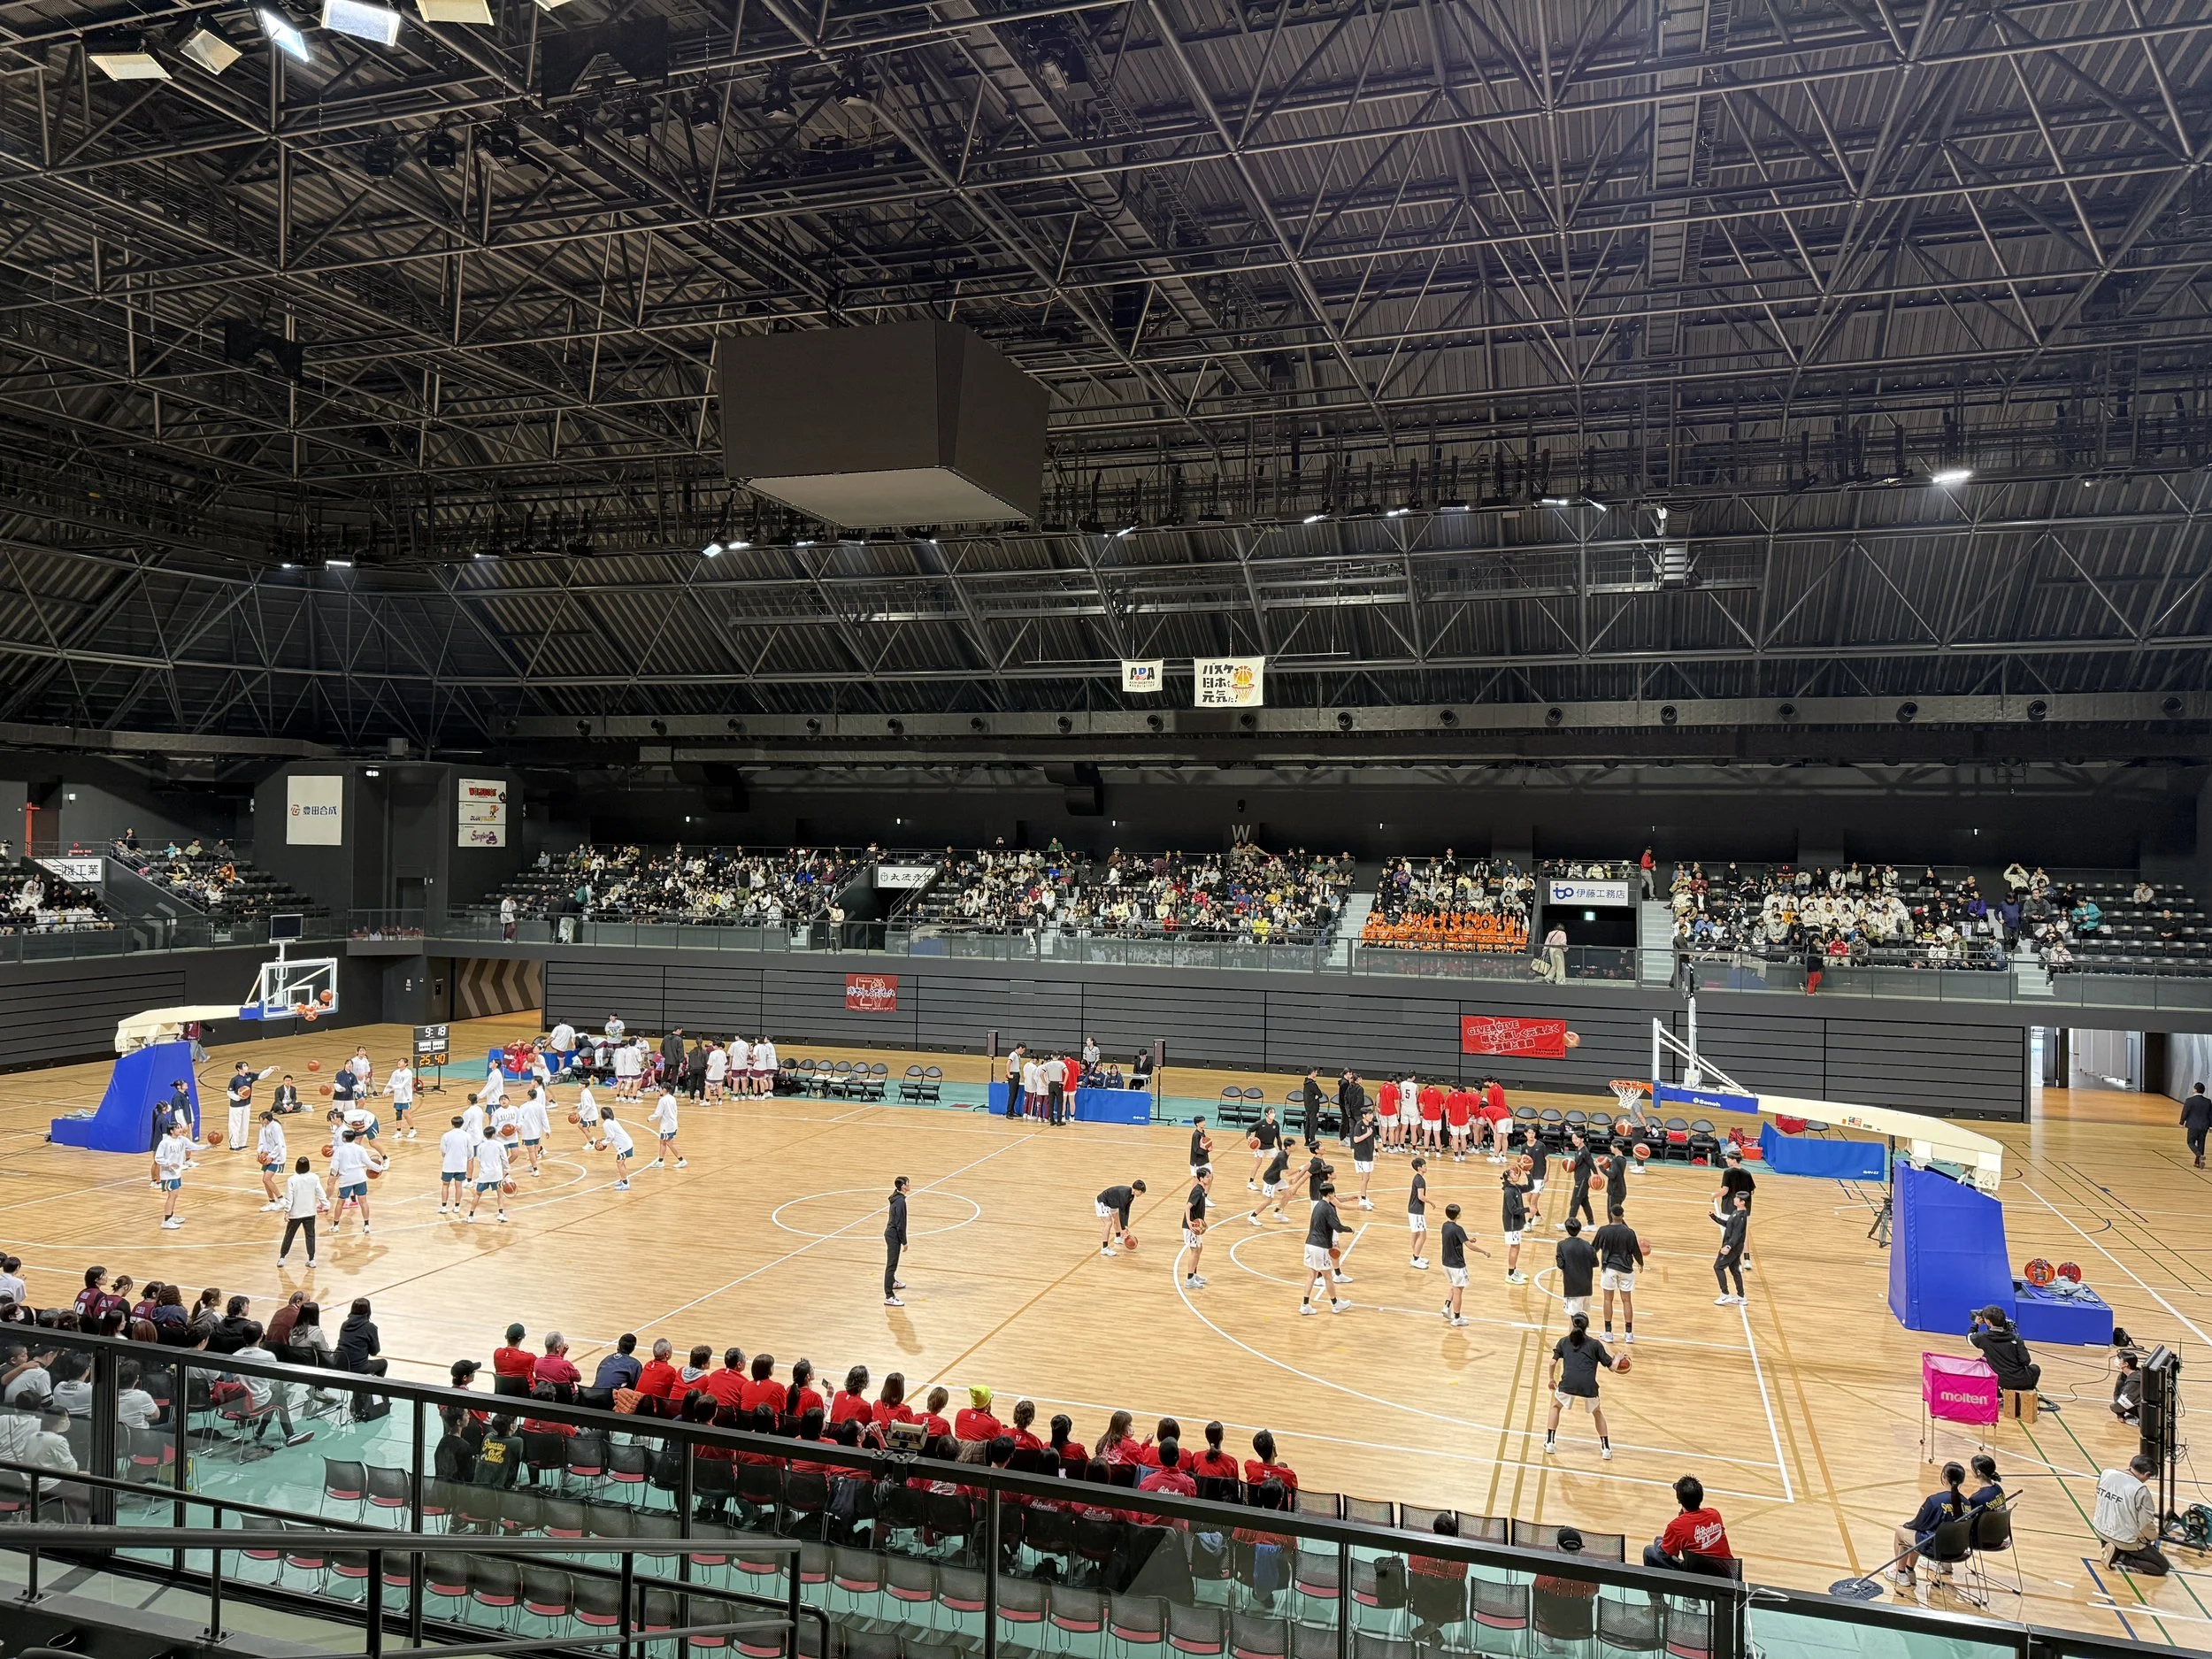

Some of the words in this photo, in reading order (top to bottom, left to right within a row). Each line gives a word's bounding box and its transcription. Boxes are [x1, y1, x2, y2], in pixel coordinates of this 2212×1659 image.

[303, 805, 337, 815] 豊田合成
[1232, 824, 1251, 843] W
[1576, 888, 1625, 899] 伊藤工務店
[419, 1055, 431, 1066] 25
[434, 1053, 446, 1065] 40
[1405, 1089, 1410, 1099] 5
[1699, 1099, 1721, 1108] Senoh
[1940, 1390, 1988, 1405] molten
